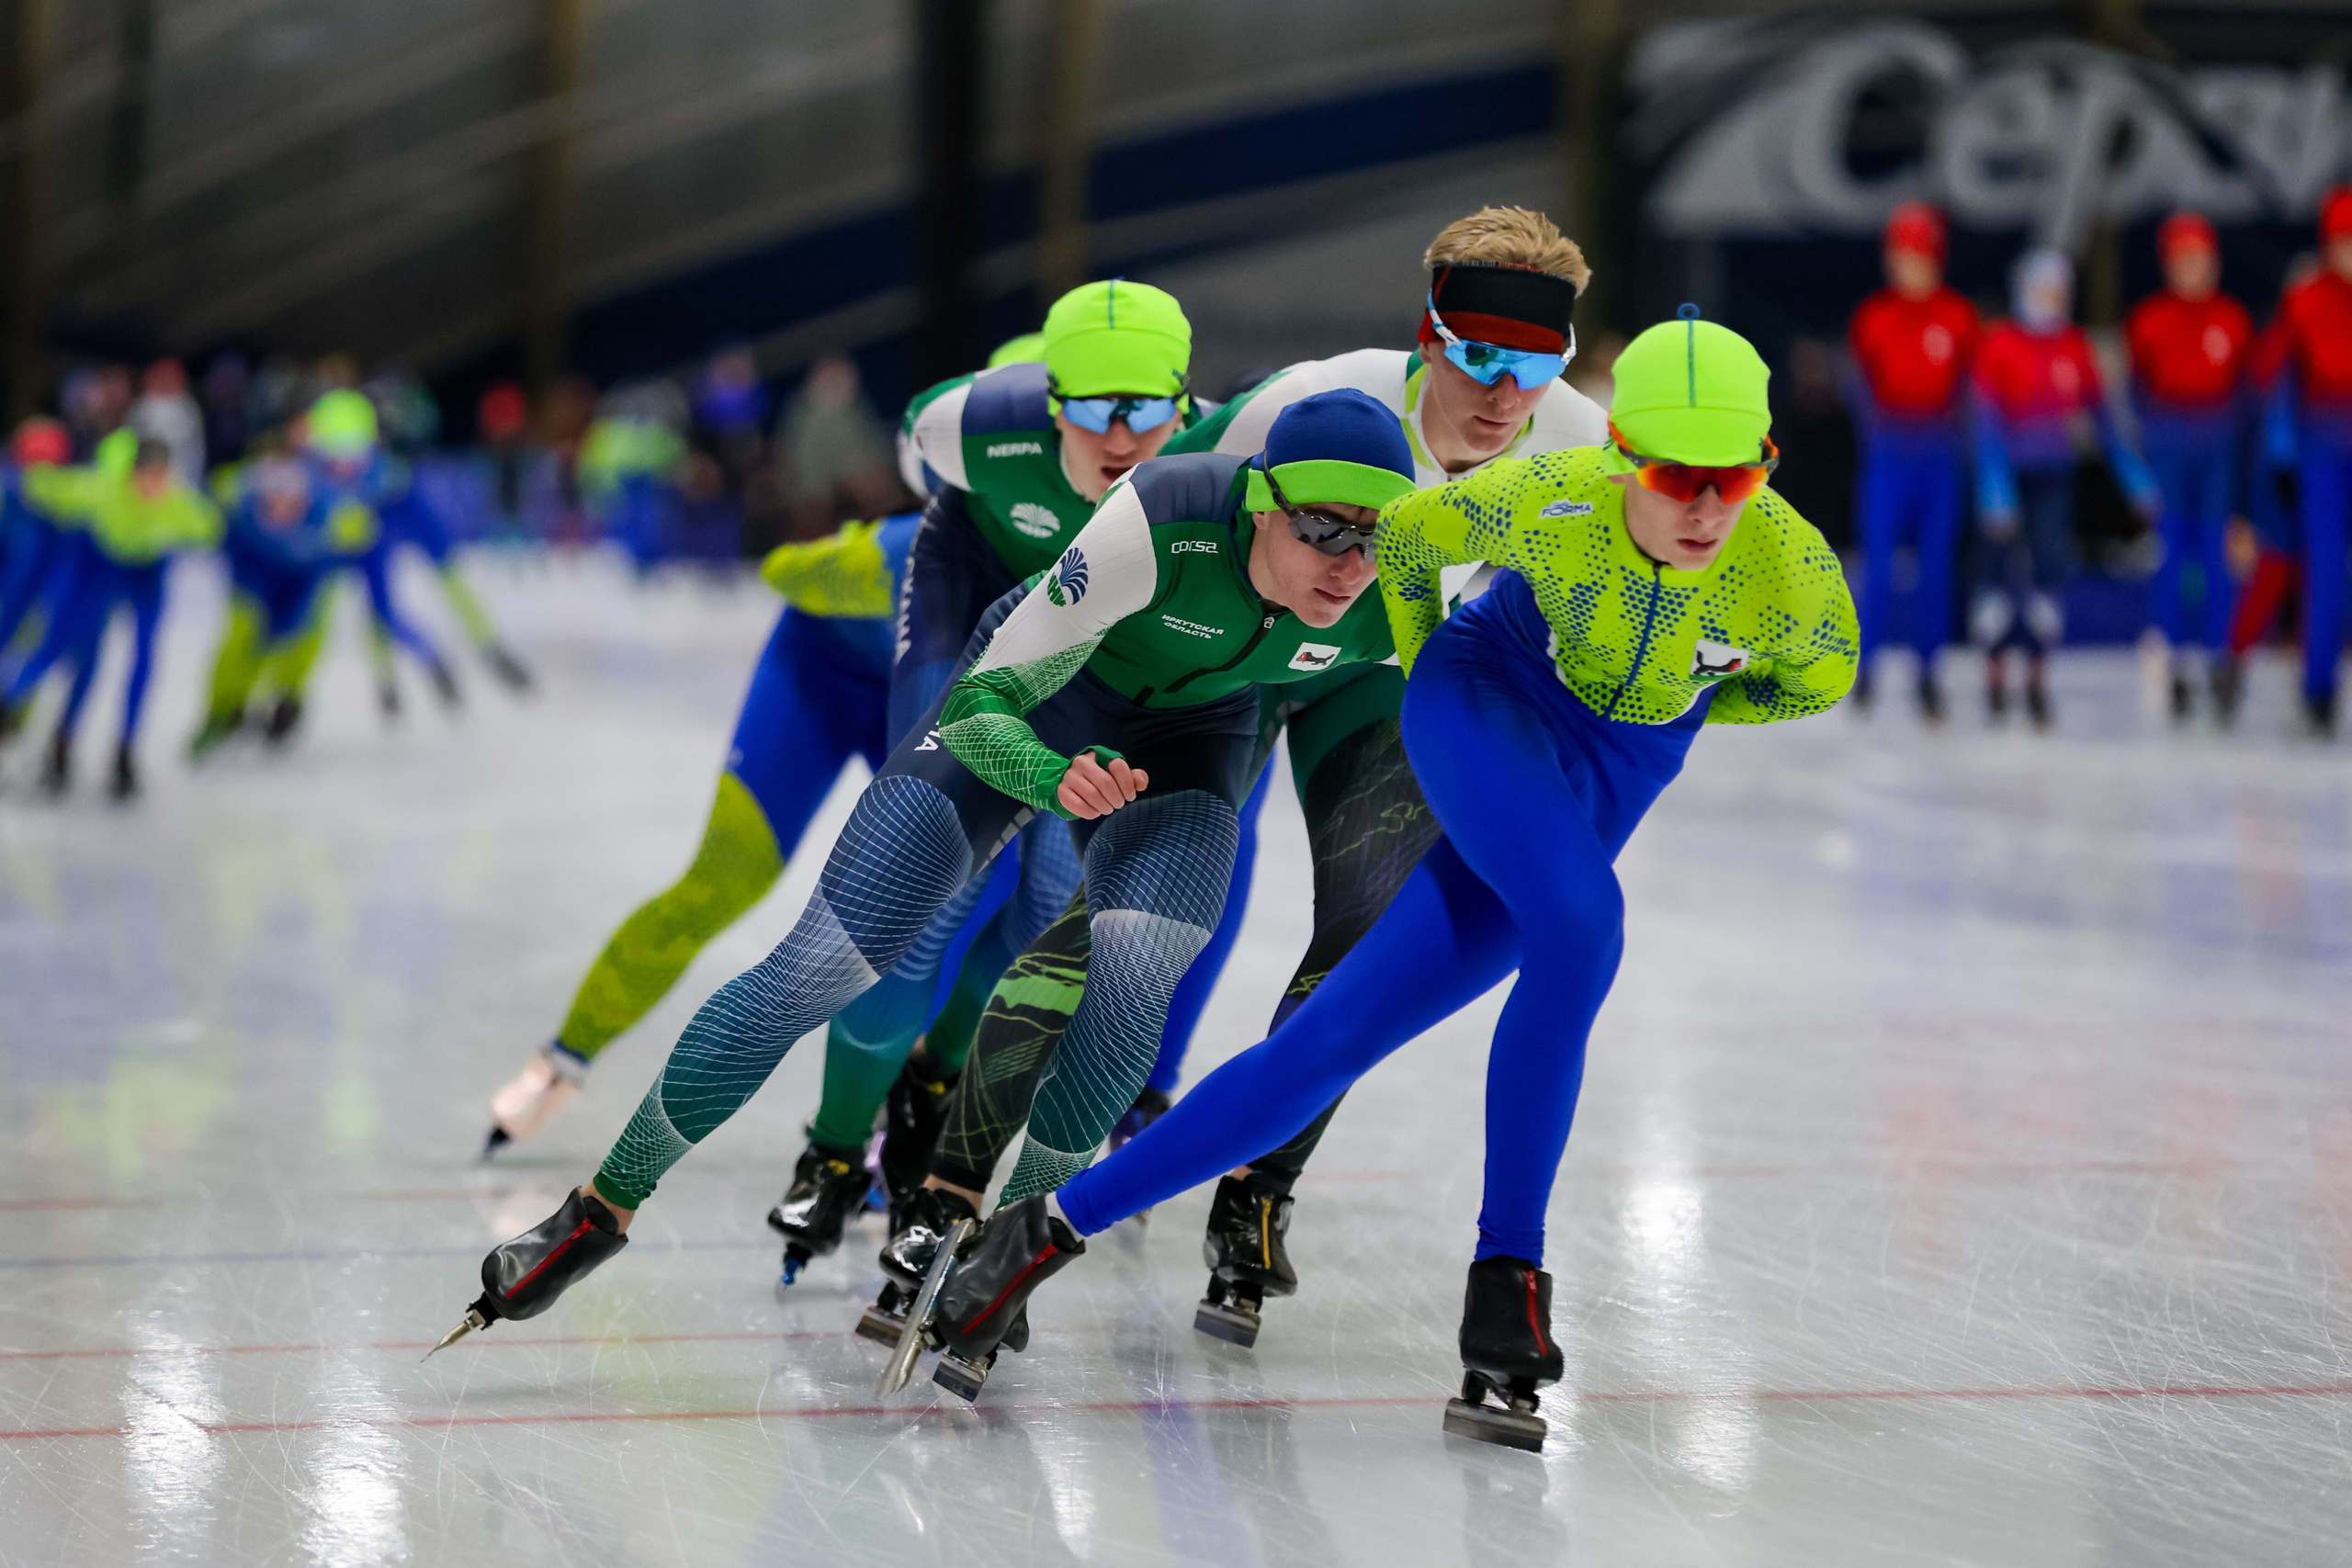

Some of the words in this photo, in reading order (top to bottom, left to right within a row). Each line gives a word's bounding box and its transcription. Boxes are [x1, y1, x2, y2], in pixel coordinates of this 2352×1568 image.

[987, 442, 1042, 458] NERPA
[1161, 615, 1224, 635] ИРКУТСКАЯ
[1164, 622, 1212, 638] ОБЛАСТЬ
